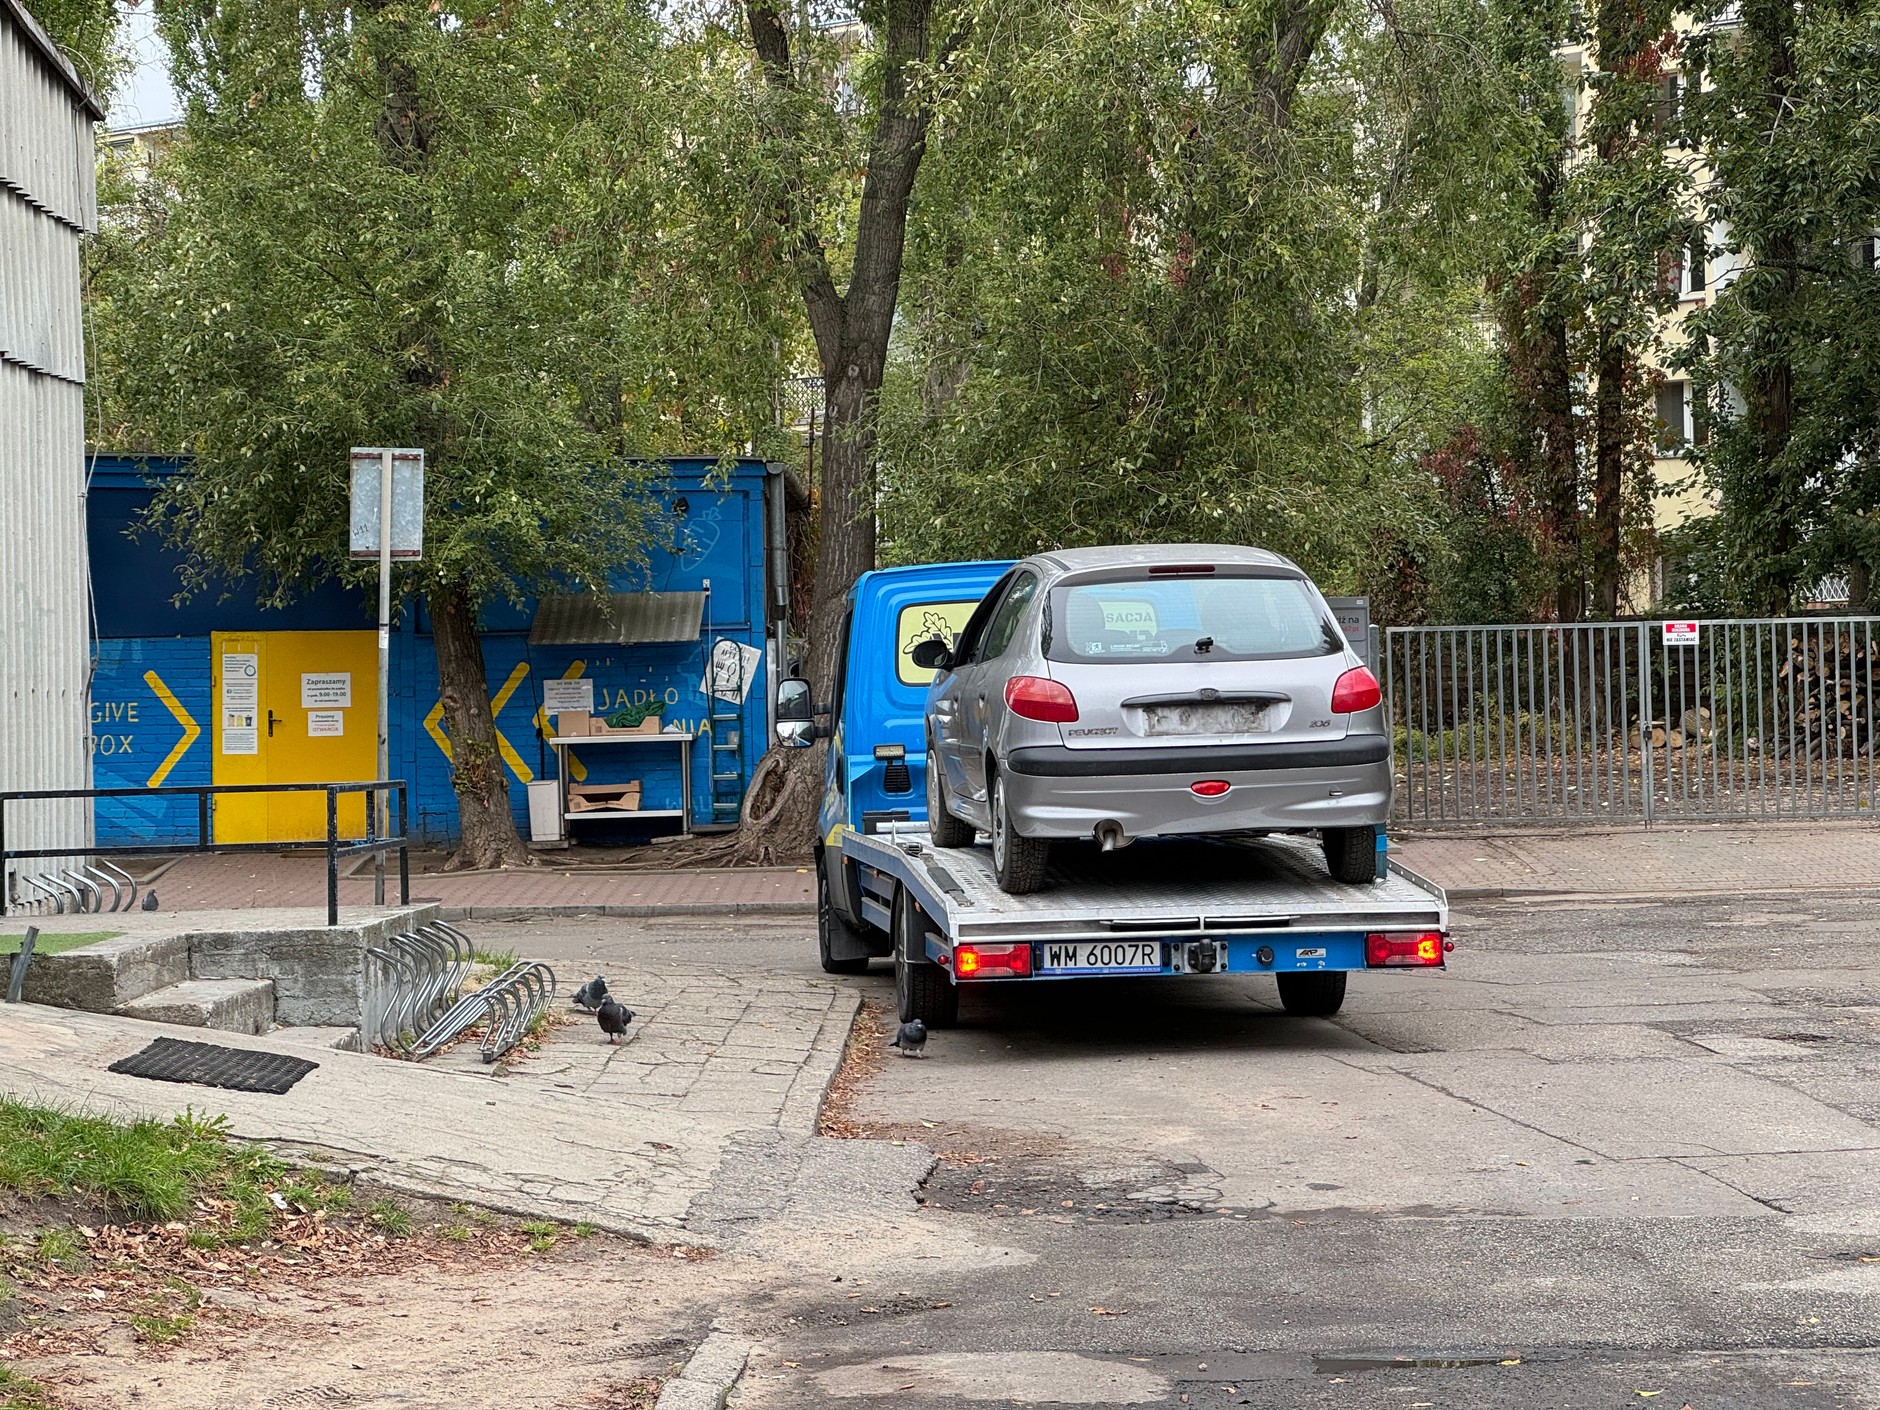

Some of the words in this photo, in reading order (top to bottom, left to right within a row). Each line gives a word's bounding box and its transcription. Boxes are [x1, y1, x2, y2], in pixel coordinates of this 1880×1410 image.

[1105, 612, 1153, 623] SACJA
[306, 678, 346, 686] Zapraszamy
[91, 702, 139, 723] GIVE
[1309, 719, 1331, 728] 206
[1068, 727, 1118, 736] PEUGEOT
[1049, 945, 1077, 967] WM
[1086, 944, 1154, 966] 6007R
